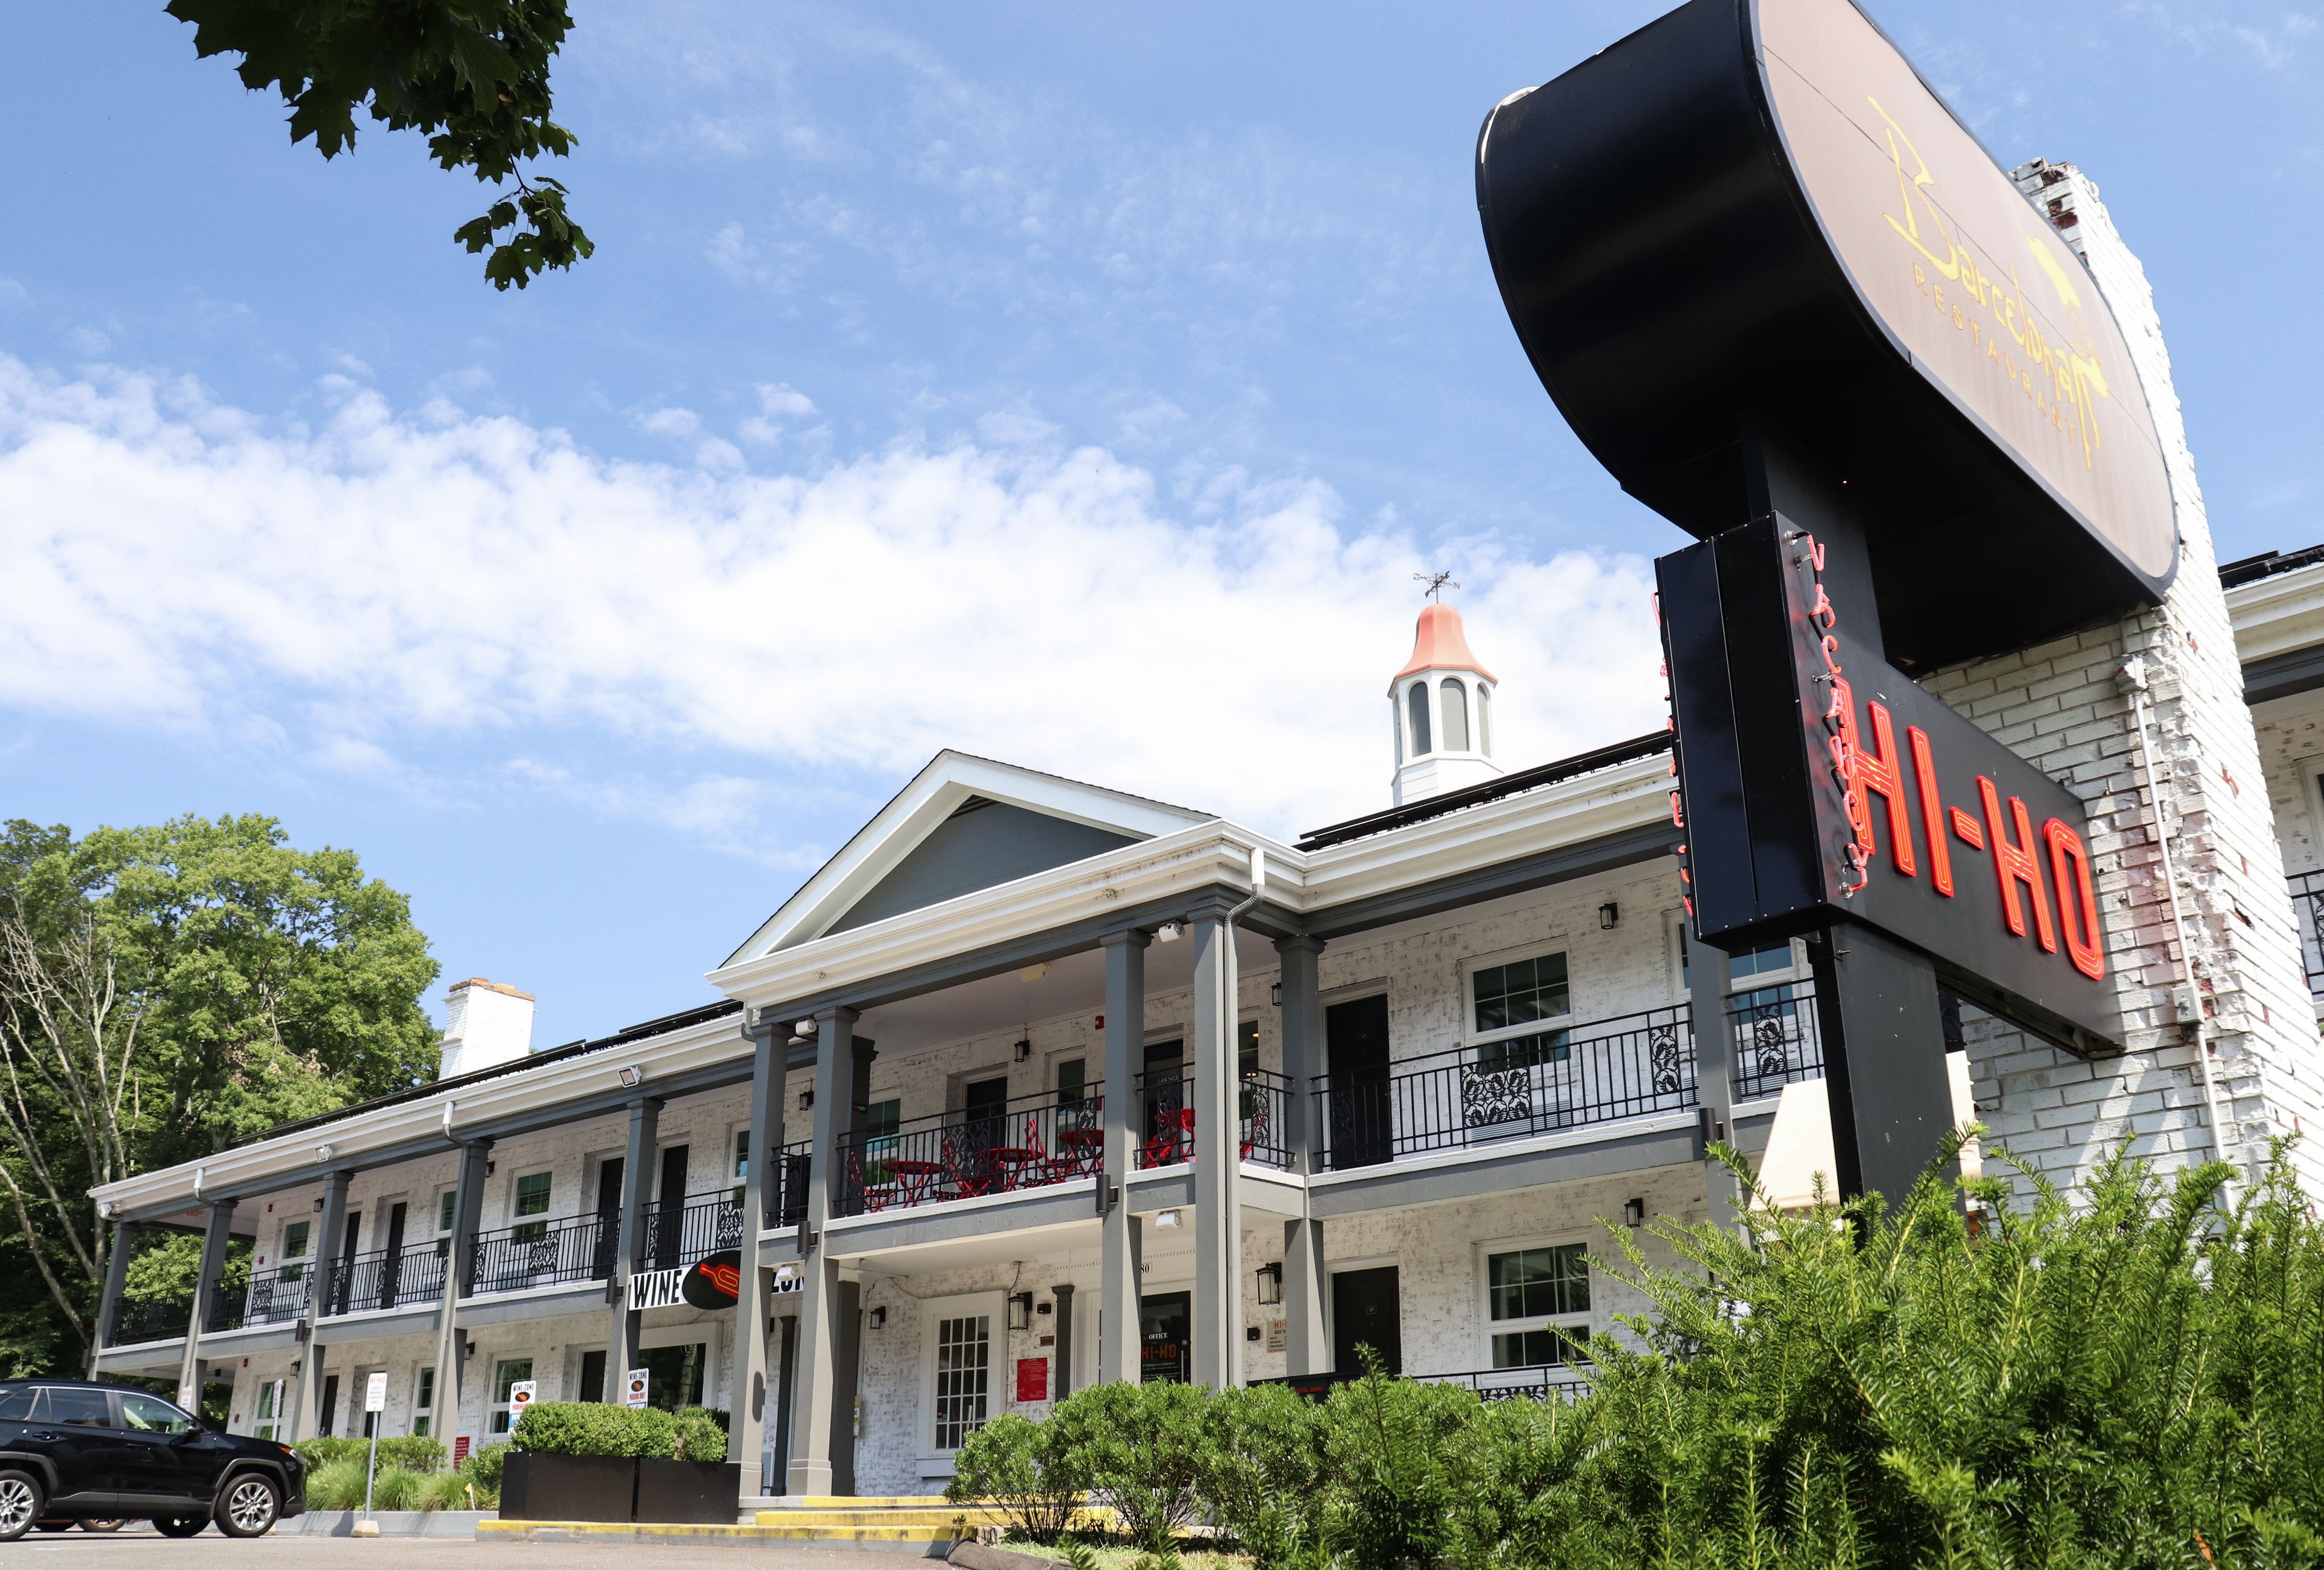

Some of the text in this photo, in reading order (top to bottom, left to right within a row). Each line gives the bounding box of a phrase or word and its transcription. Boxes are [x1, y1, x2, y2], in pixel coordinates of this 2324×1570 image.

[1868, 95, 2078, 410] Barcelona
[1914, 263, 2076, 444] RESTAURANT
[1834, 674, 2106, 981] HI-HO
[634, 1270, 682, 1309] WINE
[513, 1383, 534, 1391] WINE-ZONE
[1141, 1344, 1177, 1360] HI-HO
